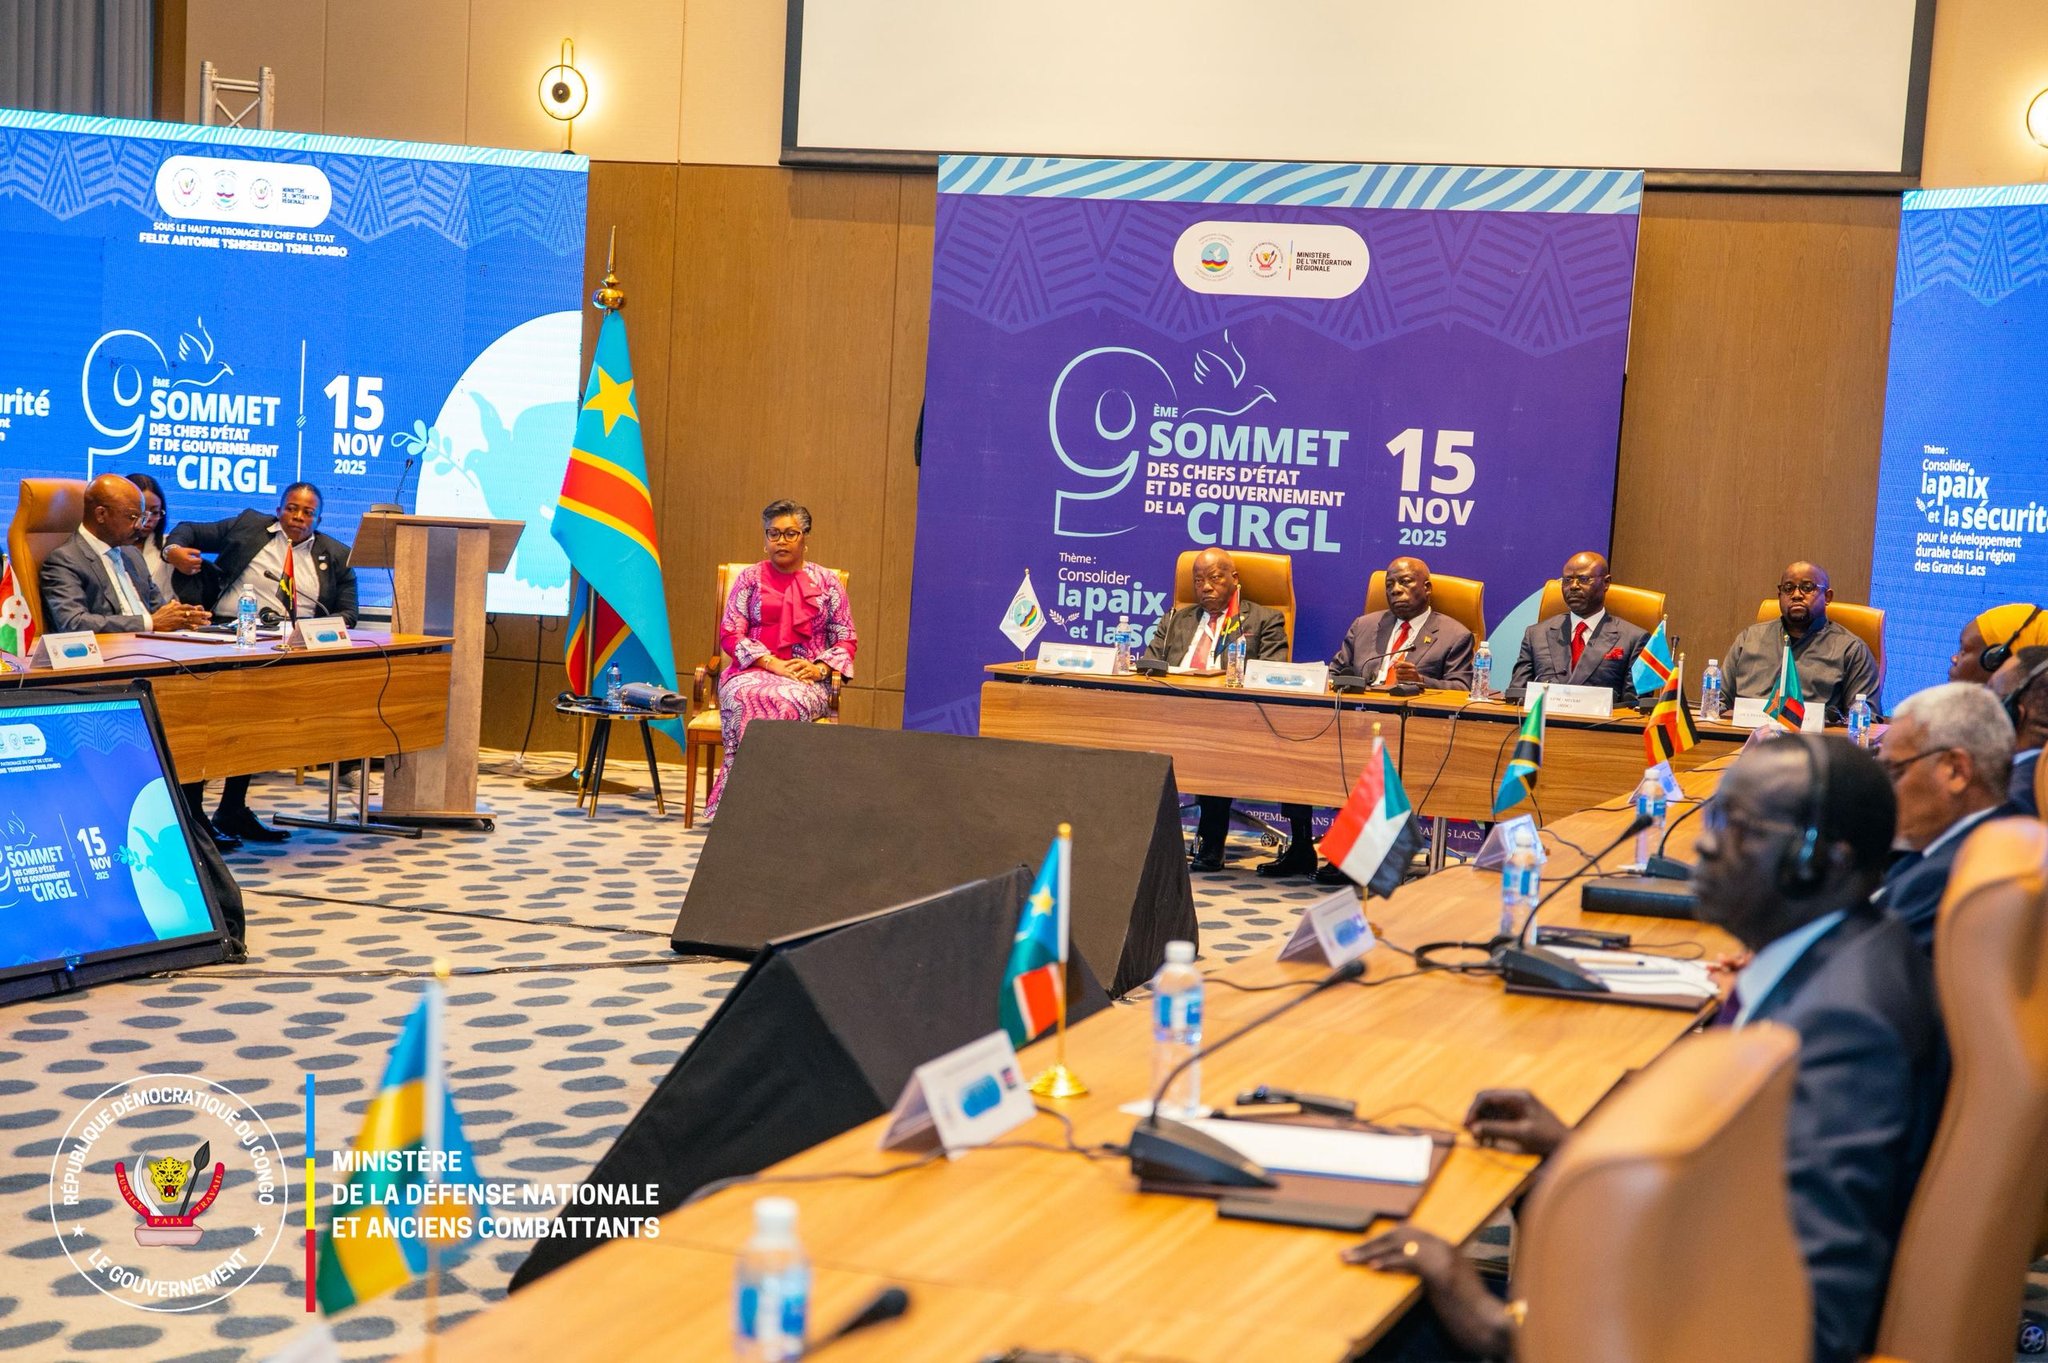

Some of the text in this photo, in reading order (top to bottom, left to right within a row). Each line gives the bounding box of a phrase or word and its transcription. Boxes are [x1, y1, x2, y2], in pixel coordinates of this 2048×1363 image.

[139, 232, 170, 245] FELIX
[171, 235, 219, 248] ANTOINE
[153, 222, 175, 231] SOUS
[176, 224, 186, 232] LE
[188, 225, 210, 234] HAUT
[211, 226, 260, 238] PATRONAGE
[261, 230, 273, 239] DU
[275, 231, 295, 240] CHEF
[297, 233, 307, 241] DE
[150, 389, 281, 426] SOMMET
[323, 375, 385, 431] 15
[1153, 403, 1178, 418] ÈME
[150, 423, 171, 436] DES
[173, 425, 209, 439] CHEFS
[149, 438, 279, 457] ET DE GOUVERNEMENT
[333, 432, 384, 457] NOV
[1148, 420, 1350, 467] SOMMET
[334, 459, 366, 475] 2025
[1386, 428, 1476, 495] 15
[1922, 458, 1970, 473] Consolider
[148, 454, 277, 494] DE LA CIRGL
[1147, 462, 1300, 486] DES CHEFS D'ÉTAT
[1146, 480, 1345, 507] ET DE GOUVERNEMENT
[1921, 468, 1990, 506] la paix
[1398, 496, 1475, 526] NOV
[1927, 499, 2048, 534] et la sécurit
[1144, 500, 1341, 553] DE LA CIRGL
[1398, 528, 1447, 547] 2025
[1917, 531, 2022, 549] pour le développement
[1059, 552, 1092, 564] Thème
[1915, 546, 2016, 566] durable dans la région
[1058, 567, 1131, 585] Consolider
[1914, 560, 1986, 577] des Grands Lacs
[1058, 581, 1167, 621] la paix
[1069, 624, 1089, 640] et
[76, 826, 107, 857] 15
[6, 846, 64, 868] SOMMET
[89, 856, 112, 871] NOV
[31, 879, 78, 902] CIRGL
